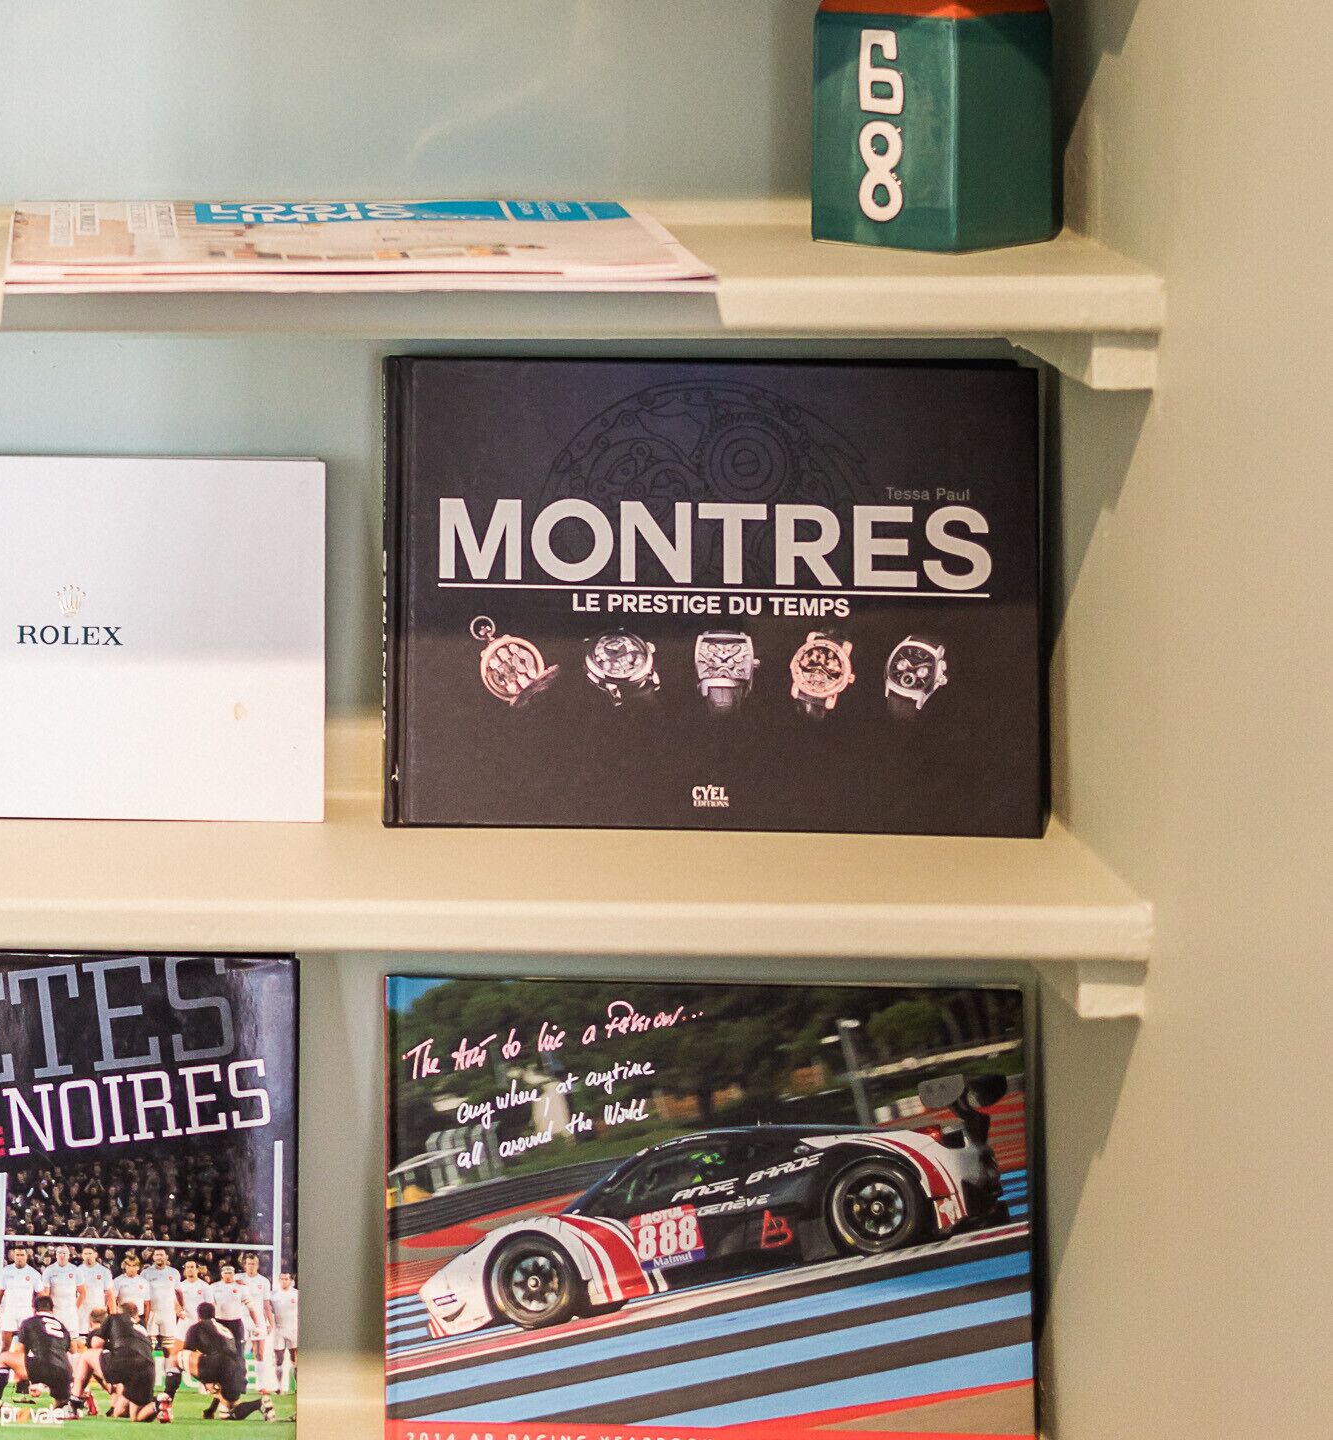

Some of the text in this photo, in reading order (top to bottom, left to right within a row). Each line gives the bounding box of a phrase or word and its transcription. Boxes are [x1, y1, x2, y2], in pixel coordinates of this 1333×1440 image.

[210, 202, 405, 214] LOGIS
[884, 486, 971, 502] Tessa Paul
[438, 497, 993, 592] MONTRES
[572, 592, 850, 619] LE PRESTIGE DU TEMPS
[17, 625, 124, 646] ROLEX
[404, 1038, 441, 1080] The
[582, 1024, 596, 1045] a
[555, 1076, 578, 1095] at
[2, 1058, 272, 1156] NOIRES
[457, 1097, 650, 1169] all around the World
[745, 1152, 825, 1186] BARDE
[640, 1206, 684, 1226] MOTUL
[637, 1214, 698, 1261] 888
[653, 1250, 693, 1268] Matmut
